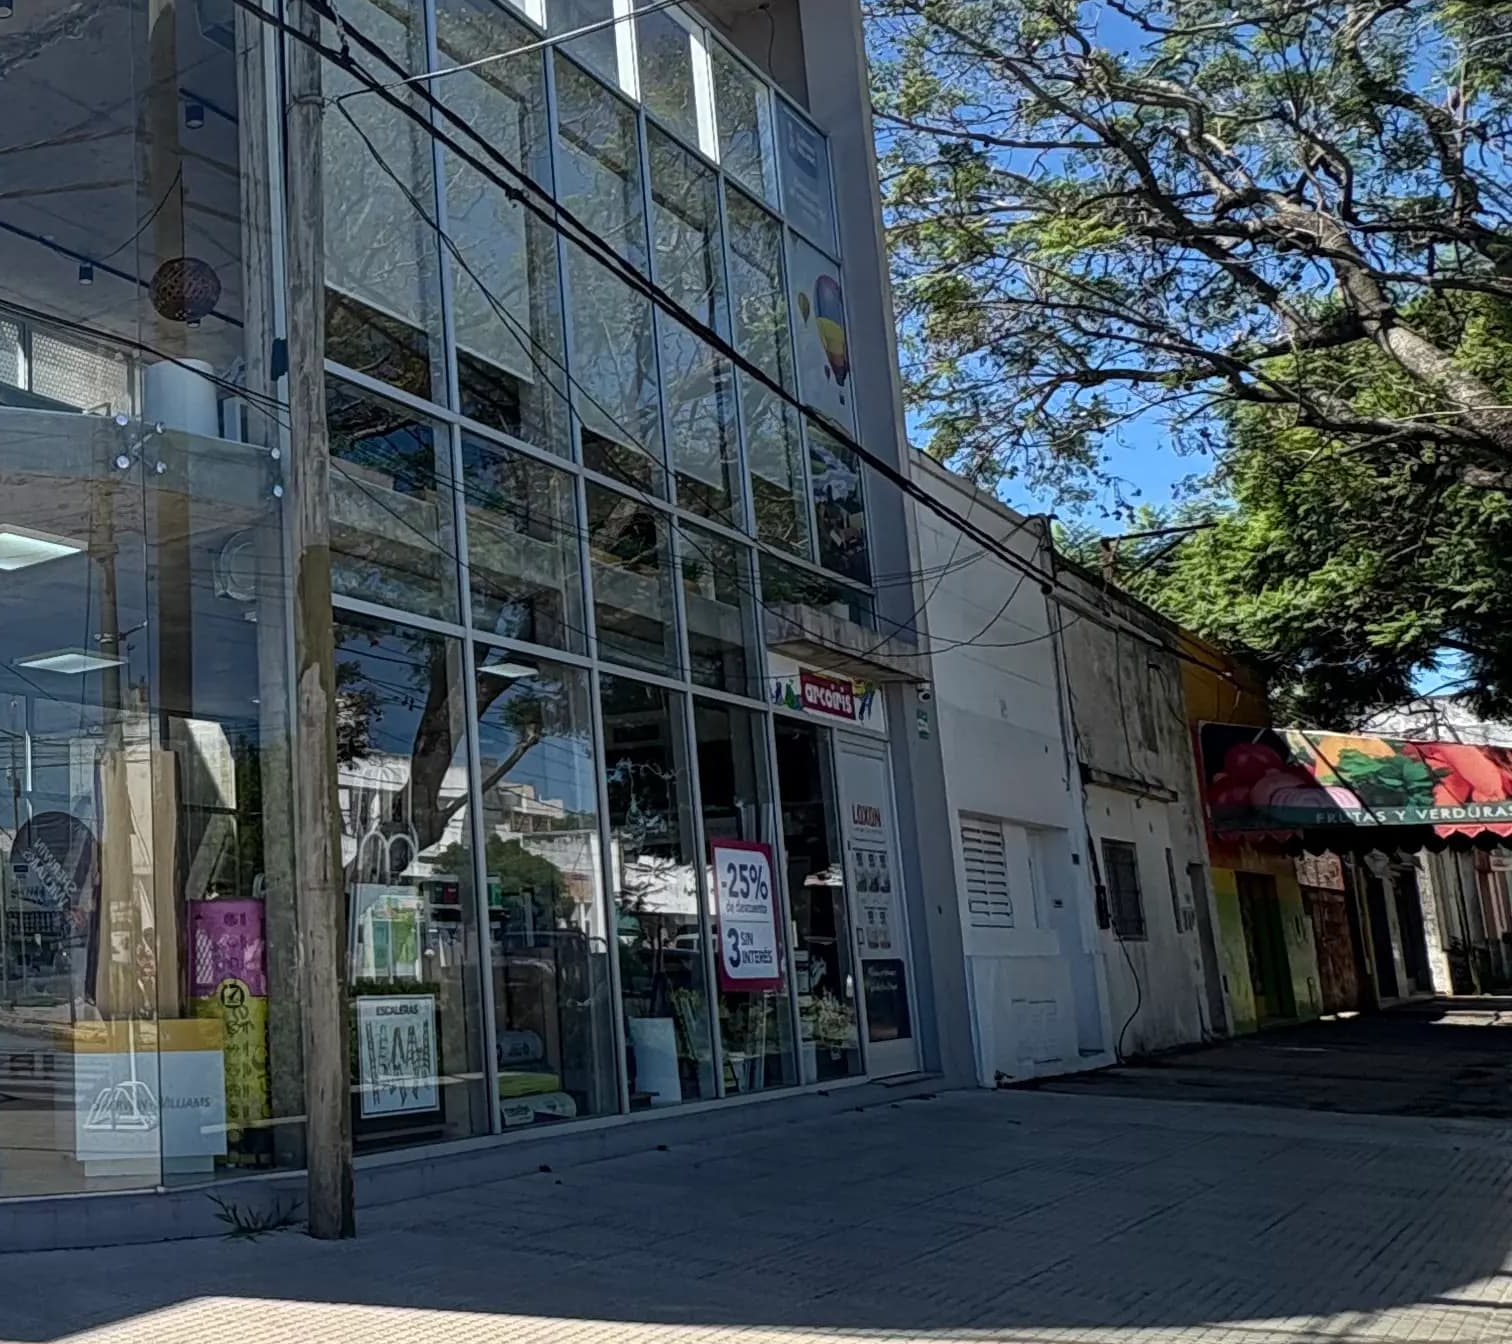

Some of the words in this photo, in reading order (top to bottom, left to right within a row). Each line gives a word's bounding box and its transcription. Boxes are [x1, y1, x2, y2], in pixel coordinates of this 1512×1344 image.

[805, 680, 852, 713] arcoiris
[1316, 810, 1386, 824] FRUTAS
[1394, 810, 1406, 821] Y
[721, 861, 768, 900] -25%
[727, 928, 741, 968] 3
[740, 931, 754, 946] SIN
[376, 1004, 419, 1017] ESCALERAS
